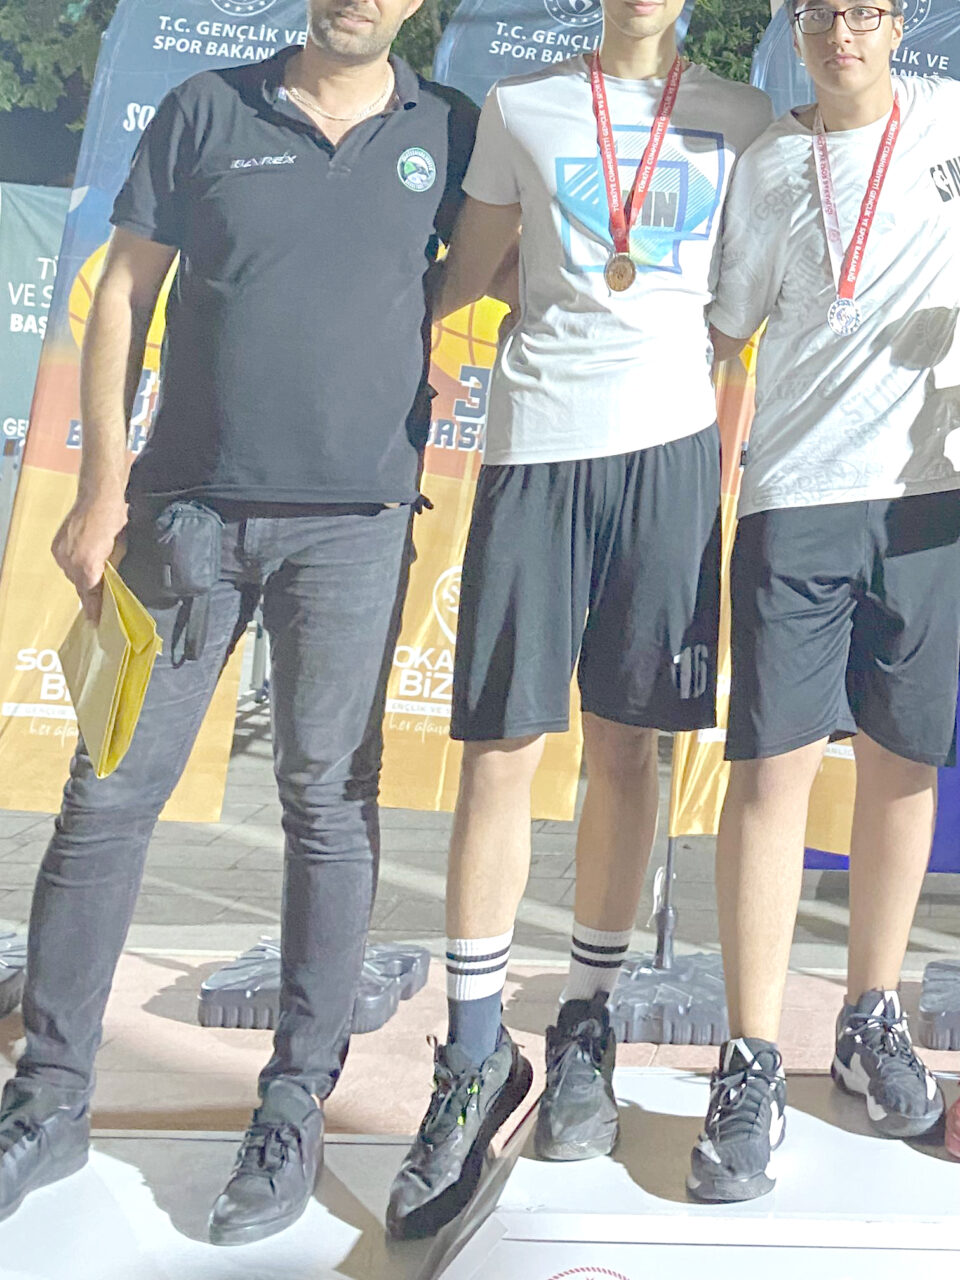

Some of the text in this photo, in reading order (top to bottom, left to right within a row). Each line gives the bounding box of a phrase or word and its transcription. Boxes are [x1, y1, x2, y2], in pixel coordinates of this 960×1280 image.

[159, 16, 307, 44] T.C. GENÇLİK VE
[496, 22, 599, 51] T.C. GENÇLİ
[153, 36, 201, 54] SPOR
[489, 40, 536, 60] SPOR
[926, 54, 949, 70] VE
[8, 282, 36, 307] VE
